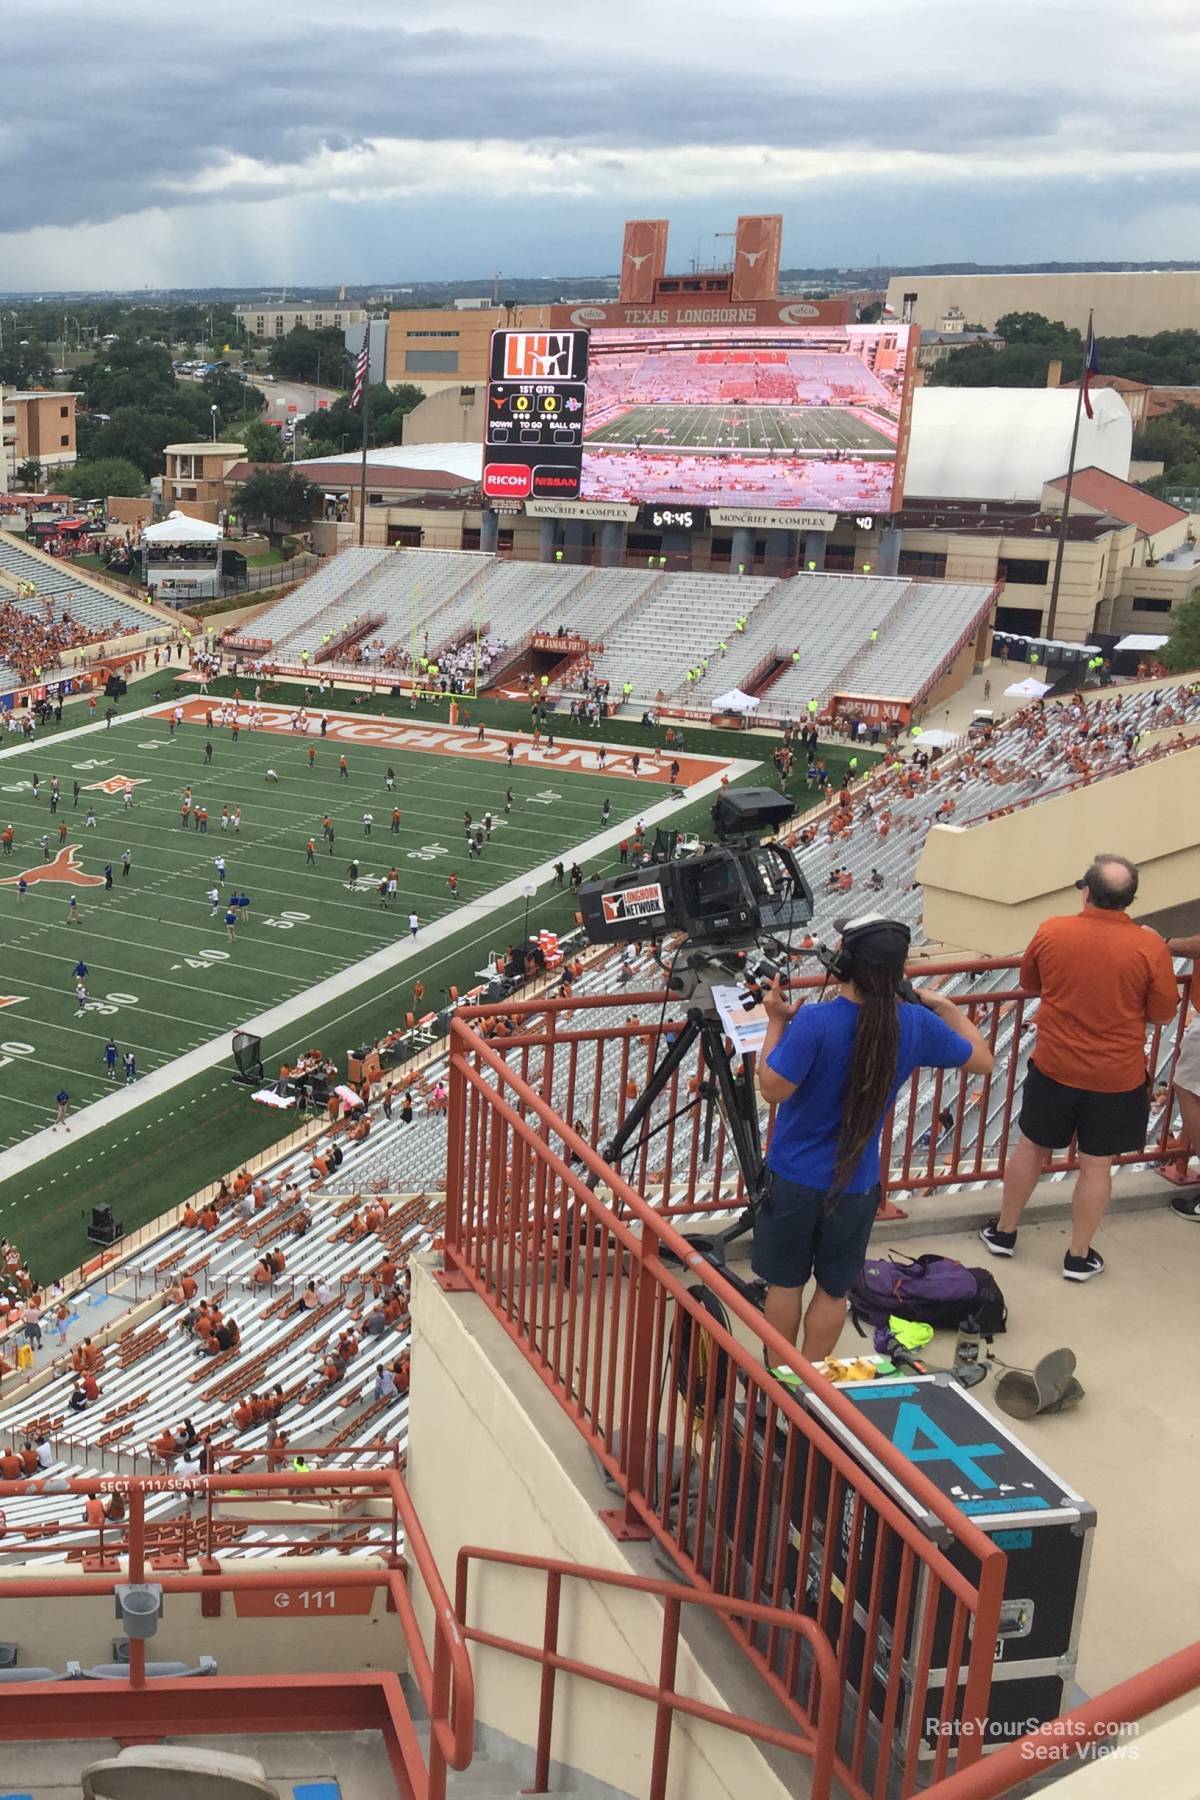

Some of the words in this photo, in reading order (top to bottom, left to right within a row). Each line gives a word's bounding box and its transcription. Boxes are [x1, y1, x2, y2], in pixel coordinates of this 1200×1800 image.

[625, 309, 669, 324] TEXAS
[676, 308, 757, 324] LONGHORNS
[520, 385, 535, 394] 1ST
[536, 385, 555, 394] QTR
[516, 396, 528, 411] 0
[544, 396, 556, 411] 0
[490, 421, 513, 429] DOWN
[520, 421, 530, 429] TO
[531, 421, 543, 429] GO
[488, 475, 527, 485] RICOH
[535, 477, 577, 487] NISSAN
[534, 505, 576, 515] MONCRIEF
[586, 508, 628, 517] COMPLEX
[653, 510, 693, 528] 69:45
[720, 513, 768, 524] MONCRIEF
[778, 515, 826, 526] COMPLEX
[855, 516, 872, 530] 40
[224, 636, 253, 646] SMOKEY
[546, 639, 567, 649] JAMAIL
[883, 703, 901, 719] XV
[190, 706, 675, 777] LONGHORNS
[623, 886, 660, 904] LONGHORN
[625, 900, 662, 917] NETWORK
[262, 910, 311, 930] 50
[182, 948, 231, 970] 40
[298, 1590, 336, 1609] 111
